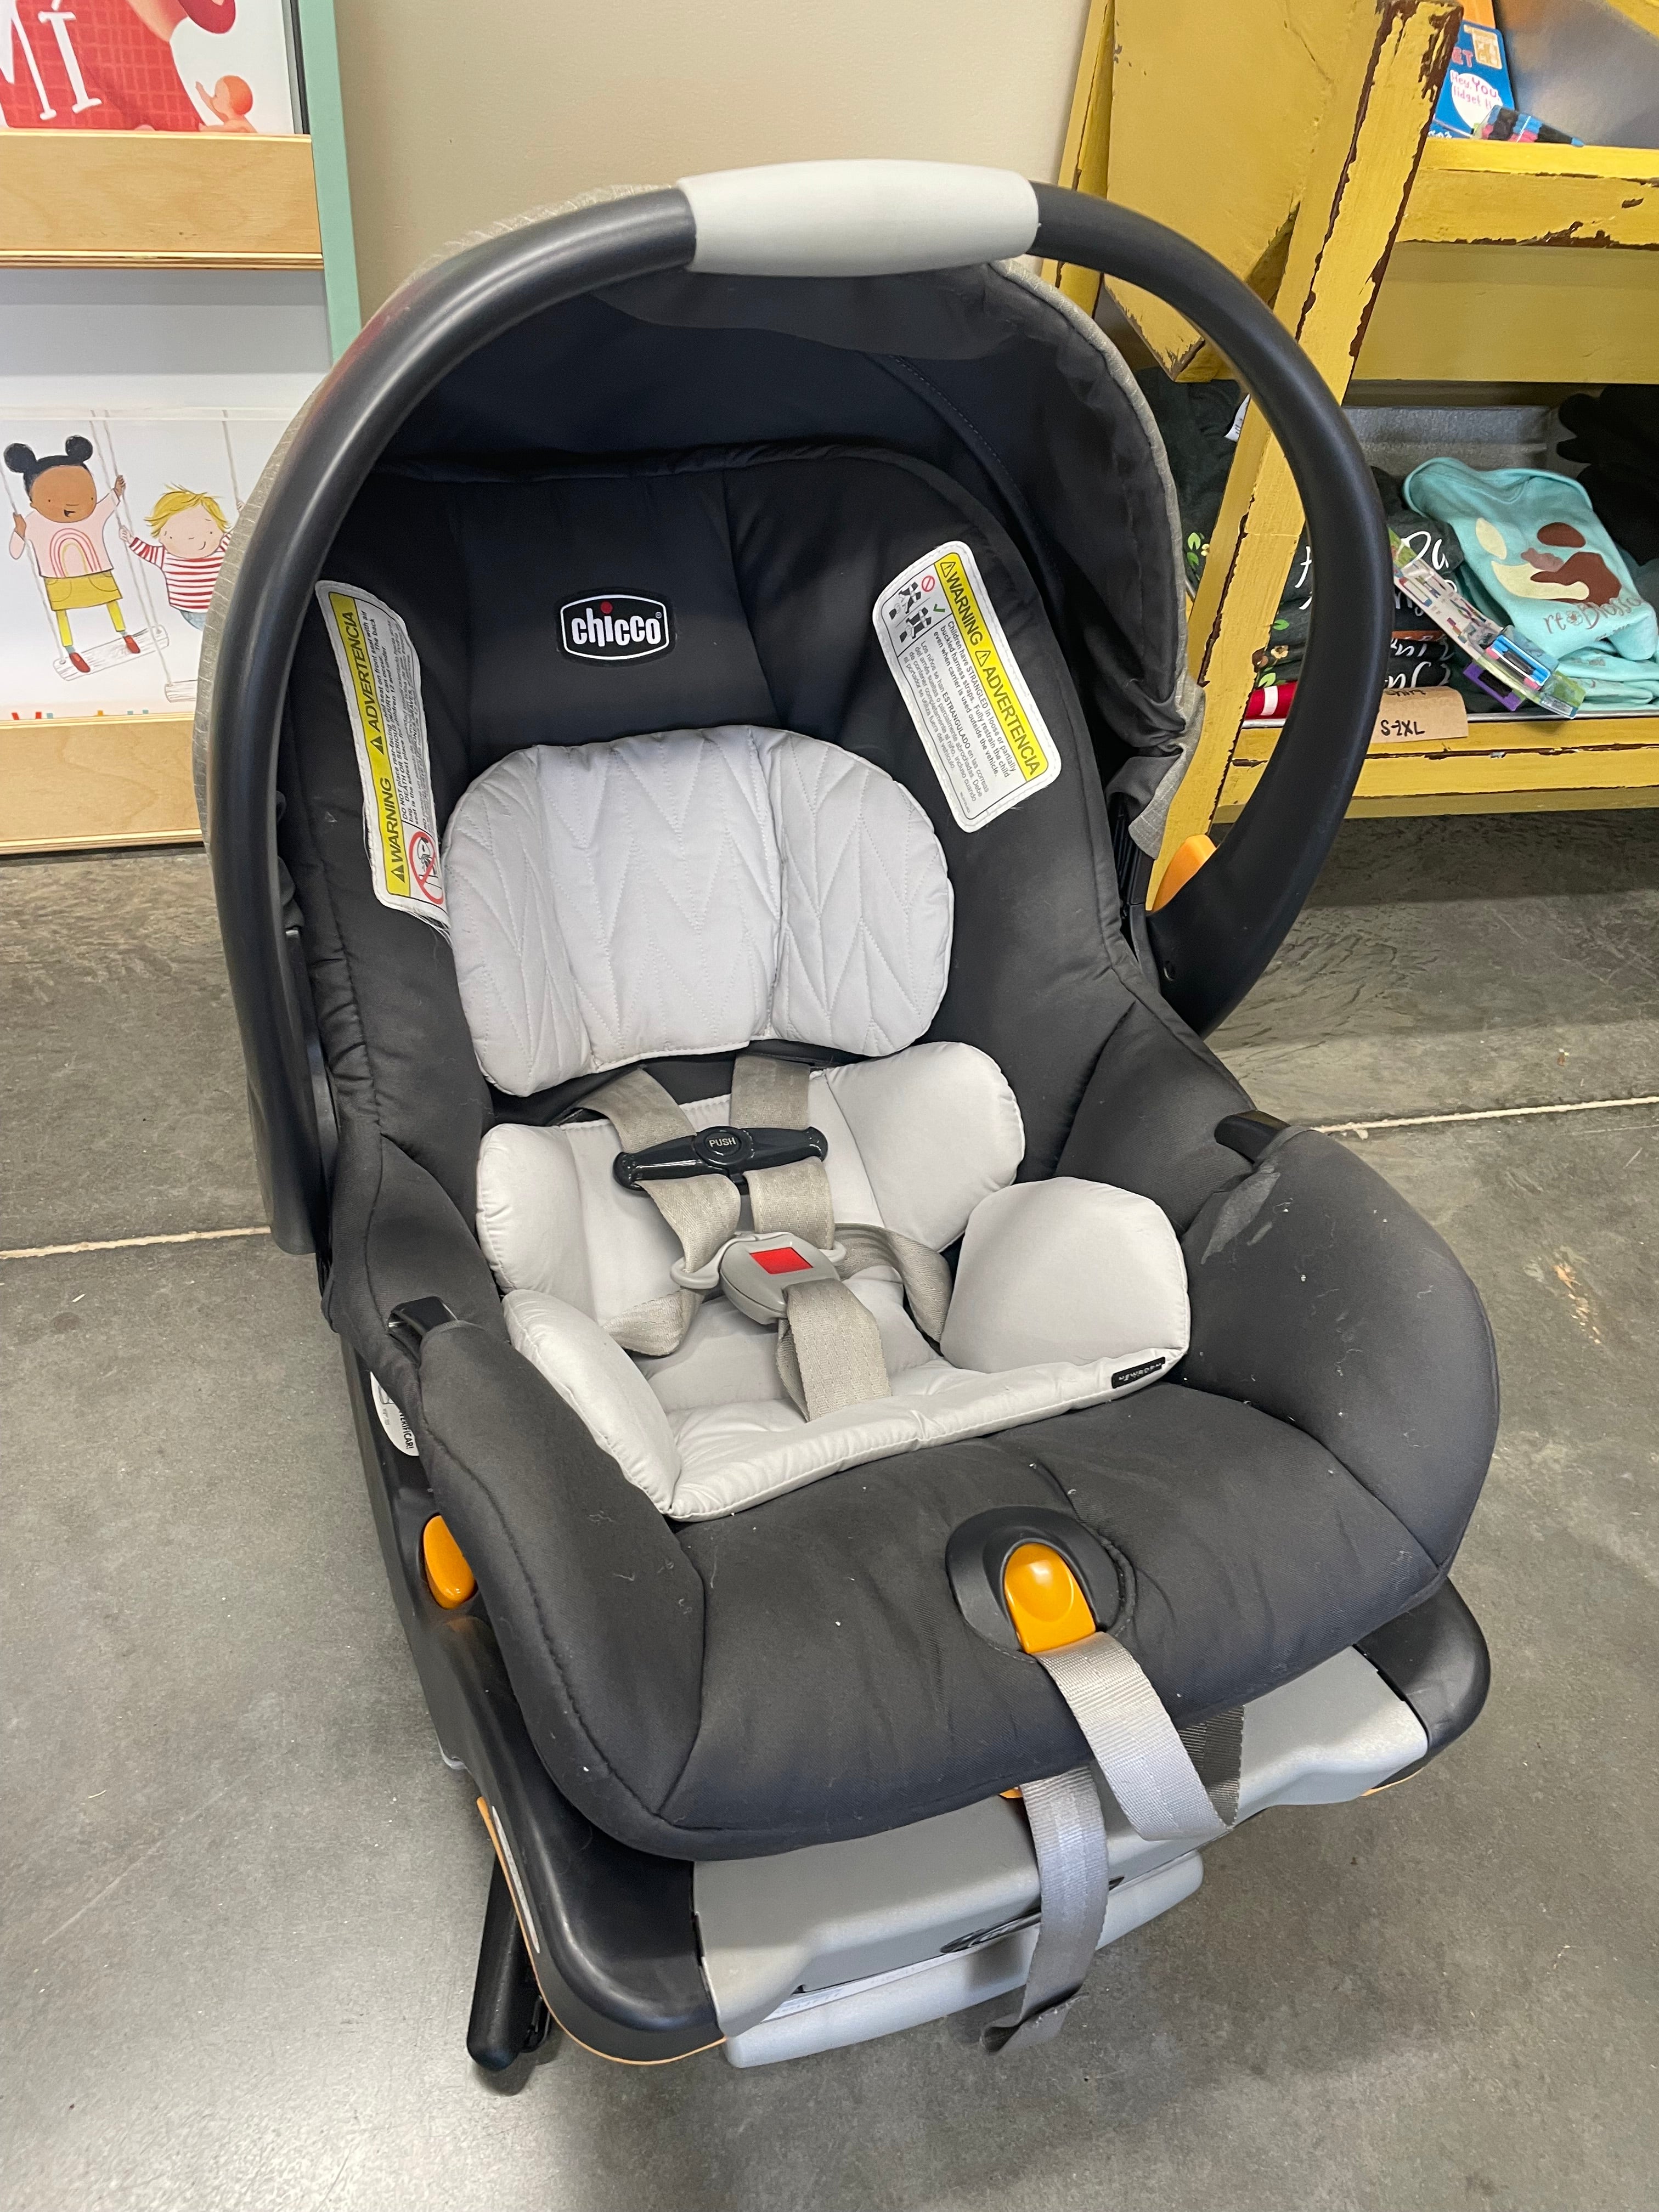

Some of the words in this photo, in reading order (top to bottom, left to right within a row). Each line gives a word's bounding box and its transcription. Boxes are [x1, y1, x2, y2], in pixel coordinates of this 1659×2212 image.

[946, 573, 983, 645] WARNING
[363, 622, 371, 637] with
[369, 619, 378, 636] back
[571, 601, 661, 647] chicco
[368, 637, 376, 654] seat
[343, 613, 380, 731] ADVERTENCIA
[371, 655, 380, 673] front
[377, 675, 383, 685] on
[390, 684, 395, 692] 12
[934, 632, 944, 648] even
[942, 648, 951, 667] when
[949, 667, 961, 688] carrier
[962, 696, 972, 713] used
[969, 714, 982, 738] outside
[385, 693, 394, 723] INJURY
[906, 664, 921, 689] portador
[918, 689, 924, 698] se
[922, 698, 932, 716] utiliza
[929, 715, 939, 733] fuera
[941, 625, 956, 653] buckled
[952, 652, 965, 680] harness
[963, 680, 975, 703] straps.
[974, 704, 984, 722] Fully
[981, 723, 996, 749] restrain
[999, 761, 1011, 778] child
[948, 621, 962, 650] Children
[960, 649, 969, 666] have
[967, 667, 988, 709] STRANGLED
[985, 709, 991, 718] in
[989, 716, 1000, 736] loose
[1000, 746, 1016, 772] partially
[380, 703, 390, 722] child
[910, 652, 916, 661] de
[913, 661, 928, 687] contener
[926, 688, 947, 733] completamente
[955, 756, 967, 778] incluso
[964, 779, 977, 802] cuando
[915, 647, 923, 657] del
[928, 675, 939, 698] sueltas
[938, 703, 958, 742] parcialmente
[973, 780, 983, 797] Debe
[927, 654, 936, 671] niños
[934, 672, 939, 680] se
[943, 692, 970, 749] ESTRANGULADO
[968, 750, 974, 759] en
[976, 770, 989, 793] correas
[984, 668, 1040, 774] ADVERTENCIA
[387, 724, 399, 765] rear-facing
[391, 724, 402, 759] SERIOUS
[399, 740, 408, 761] place
[394, 766, 404, 787] place
[398, 761, 405, 773] OR
[404, 761, 412, 785] safest
[397, 788, 405, 805] NOT
[401, 774, 410, 802] DEATH
[380, 778, 403, 862] WARNING
[401, 807, 408, 820] DO
[709, 1137, 736, 1147] PUSH
